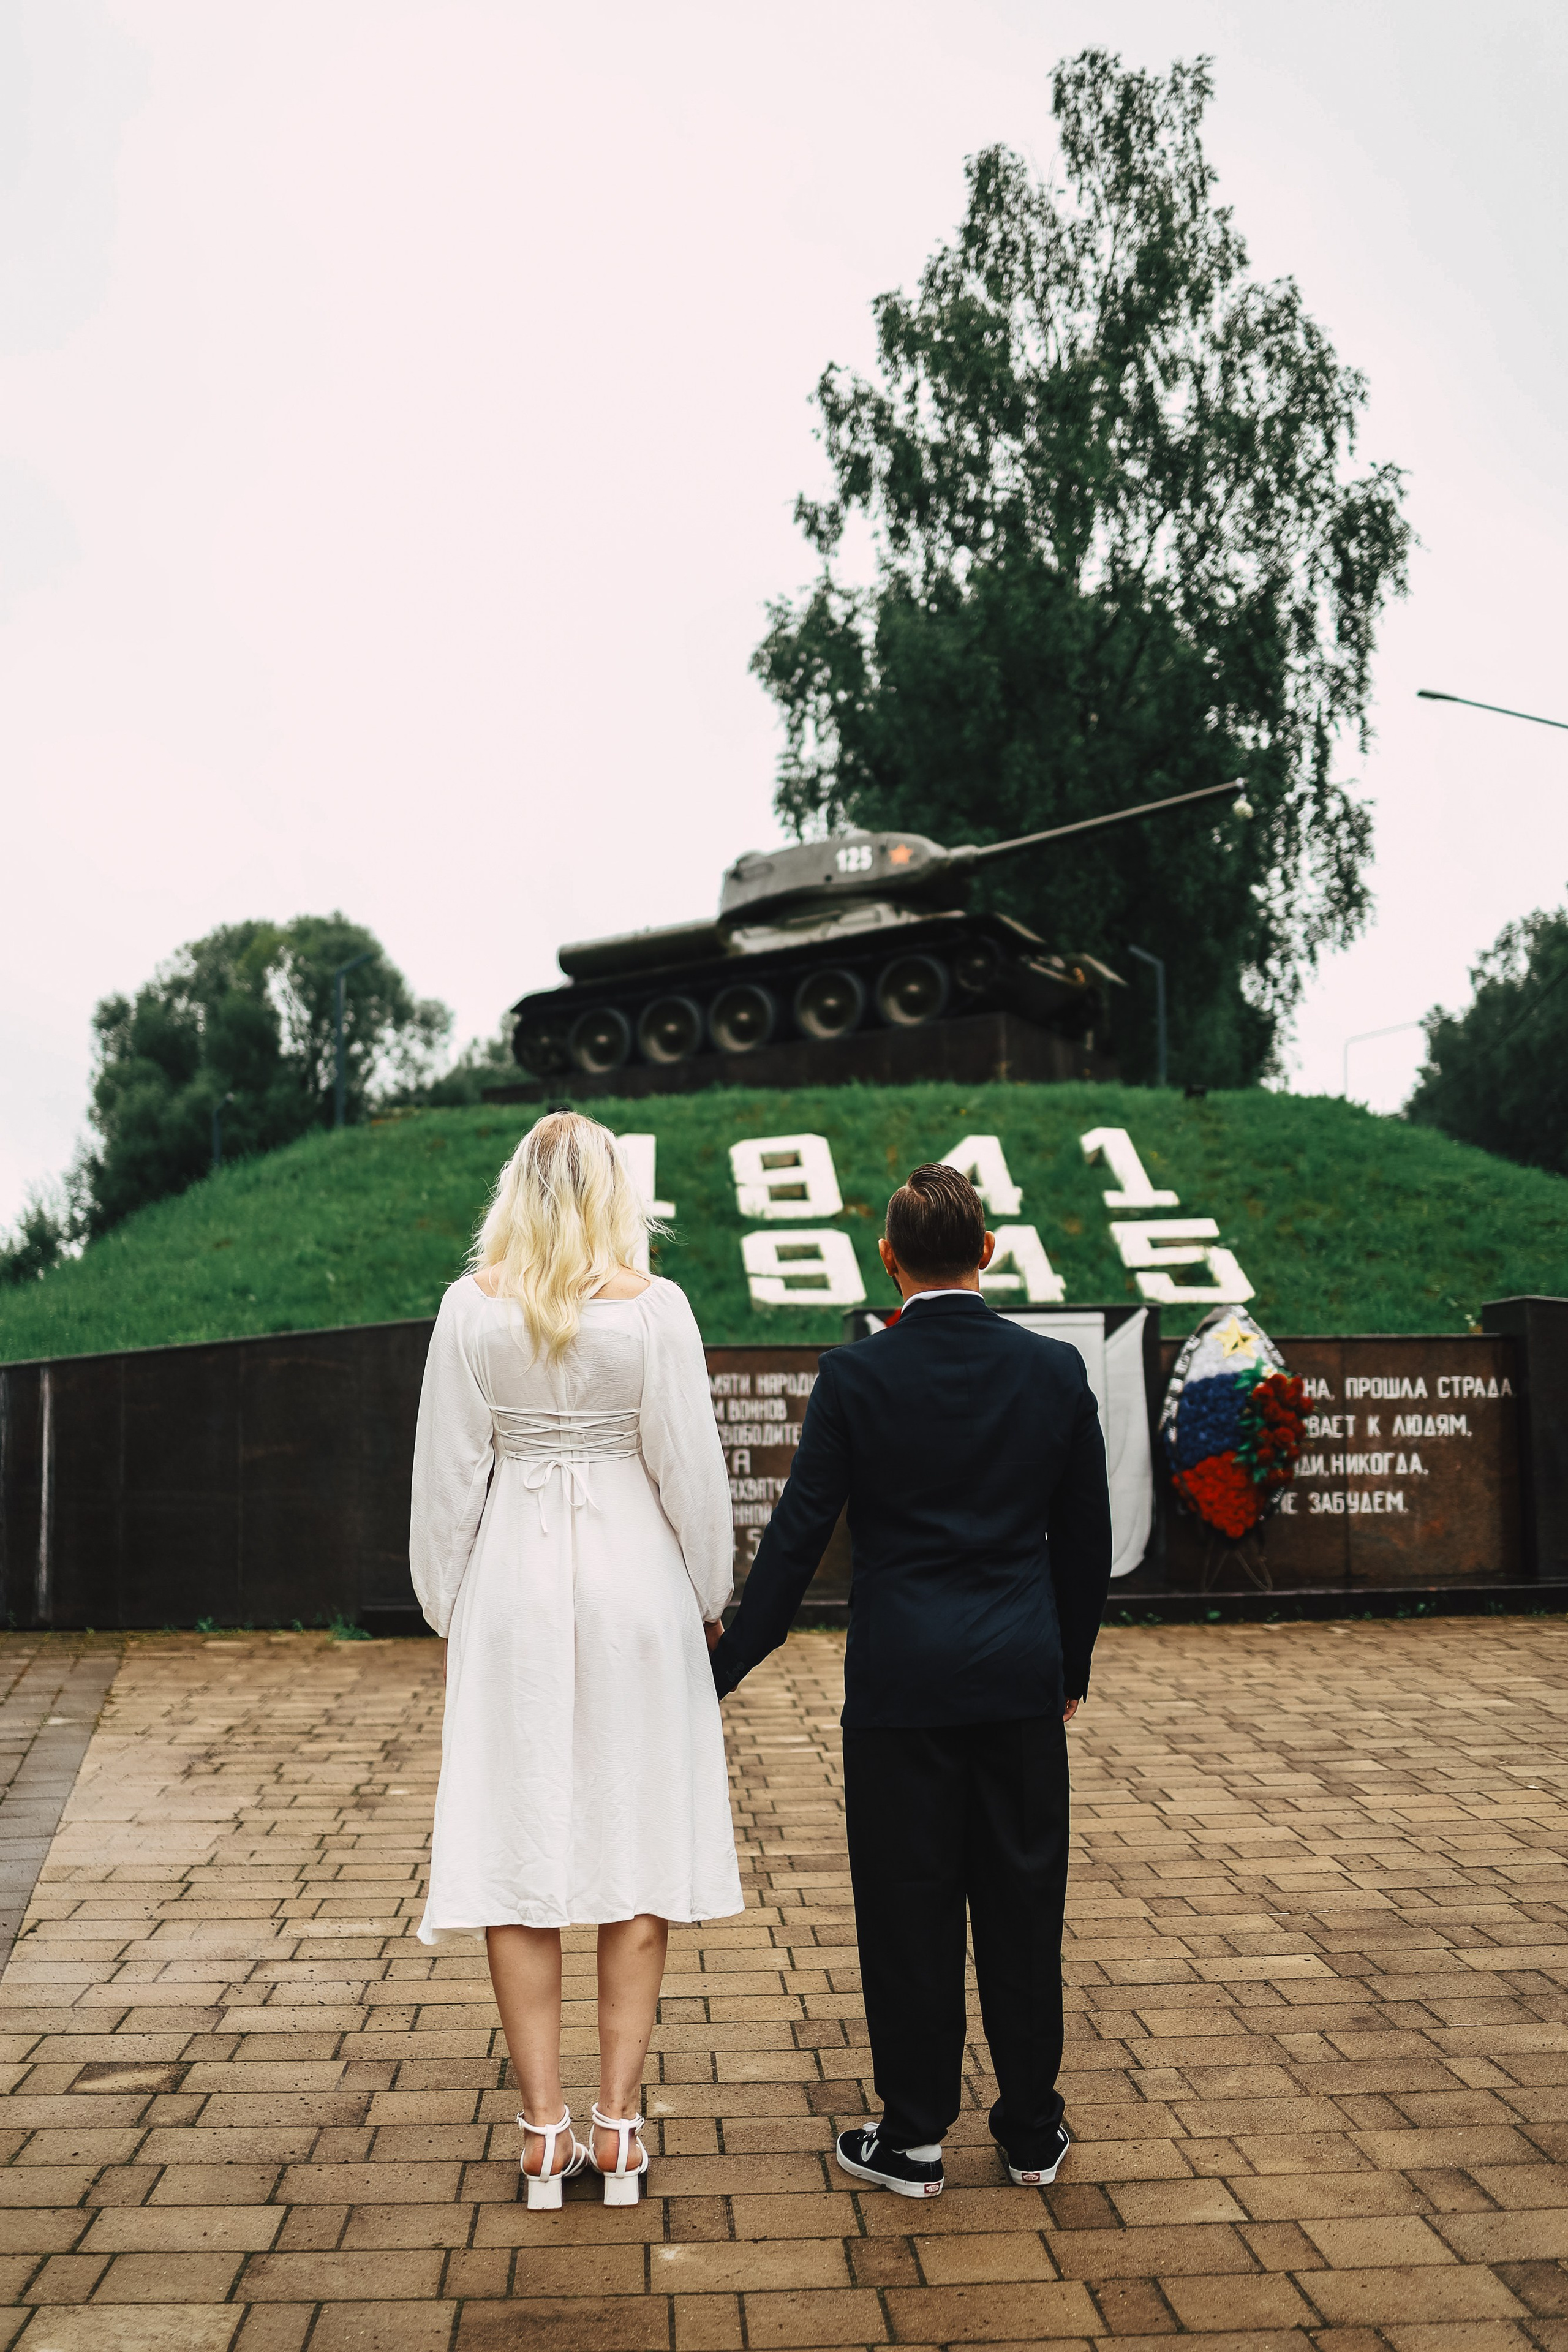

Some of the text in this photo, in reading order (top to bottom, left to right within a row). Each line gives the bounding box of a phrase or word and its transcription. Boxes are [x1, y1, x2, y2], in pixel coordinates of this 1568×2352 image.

[1345, 1376, 1428, 1400] ПРОШЛА
[728, 1398, 788, 1422] ВОИНОВ
[1303, 1415, 1356, 1438] ВАЕТ
[1367, 1414, 1381, 1438] К
